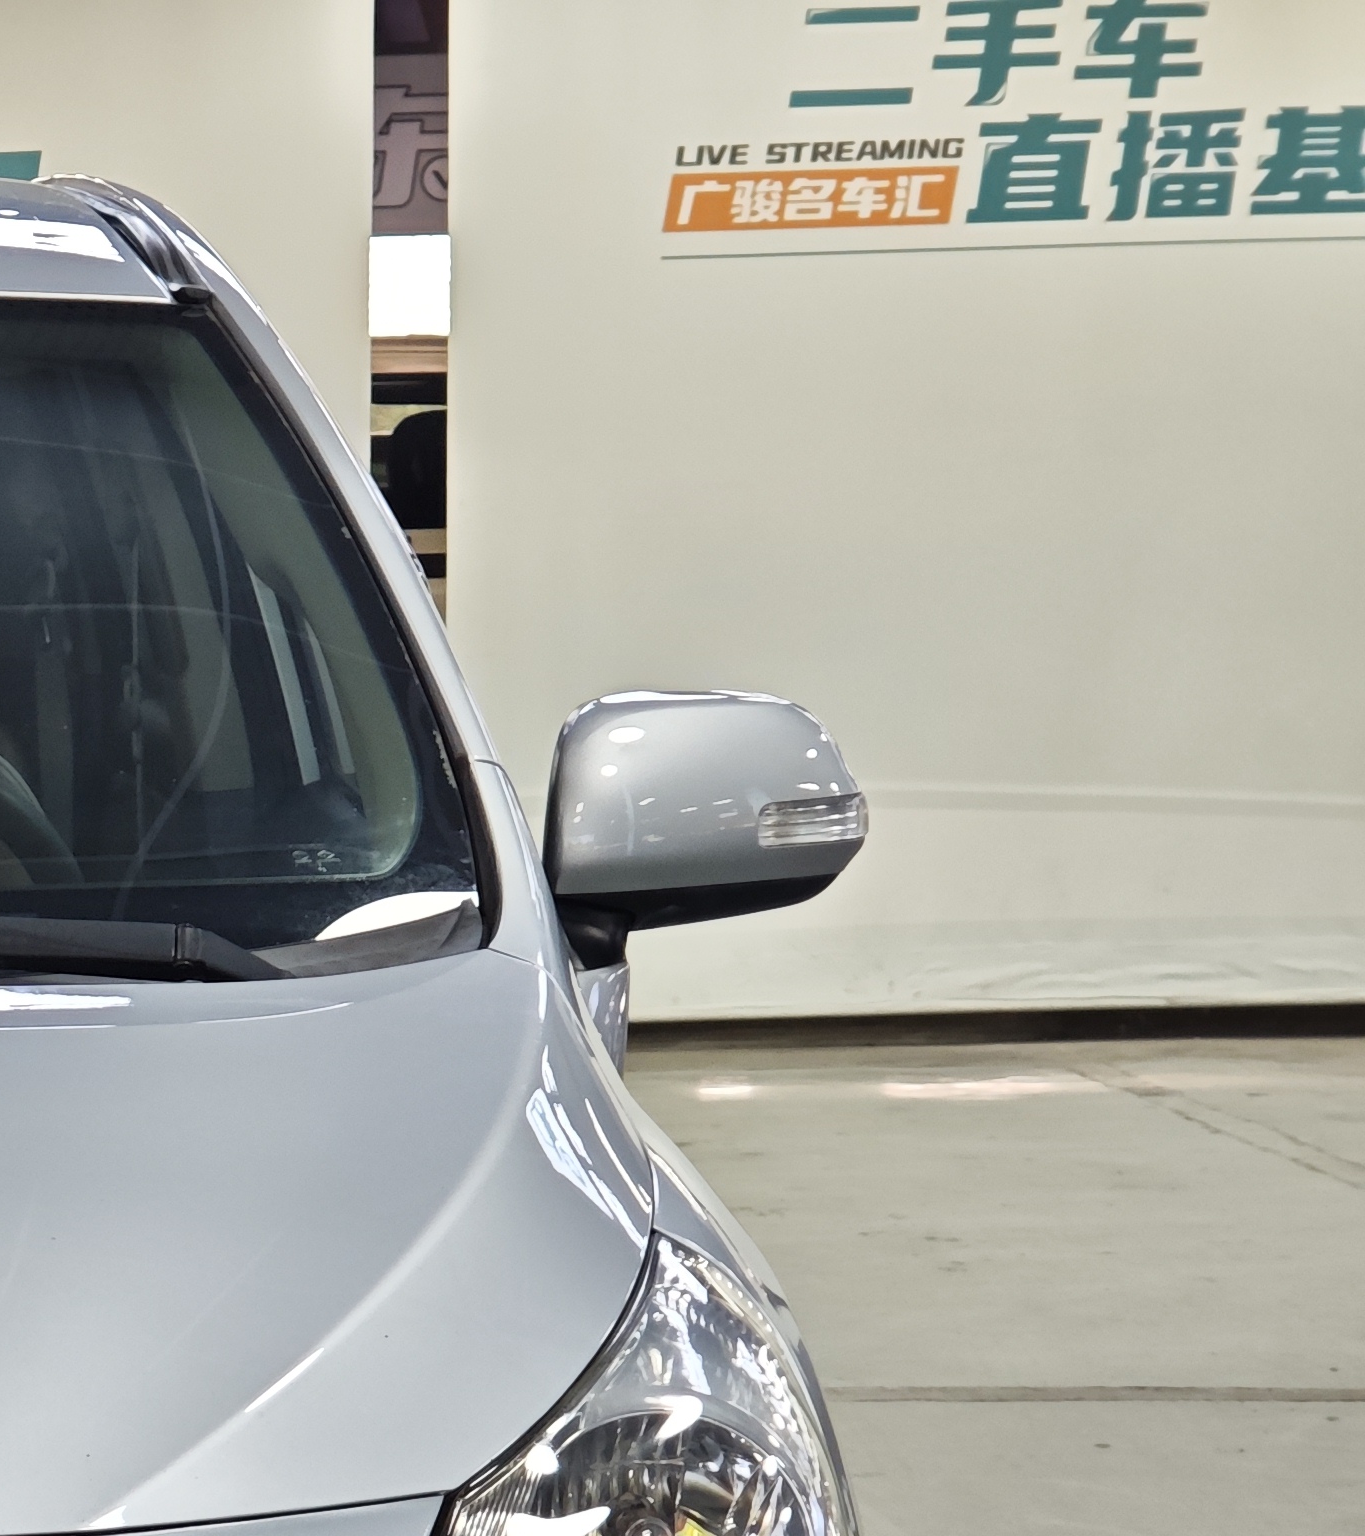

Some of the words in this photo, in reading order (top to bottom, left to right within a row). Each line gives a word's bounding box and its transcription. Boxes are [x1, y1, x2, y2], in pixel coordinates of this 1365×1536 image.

[788, 0, 1208, 107] 二手车
[675, 145, 749, 167] LIVE
[764, 138, 965, 165] STREAMING
[676, 174, 946, 226] 广骏名车汇
